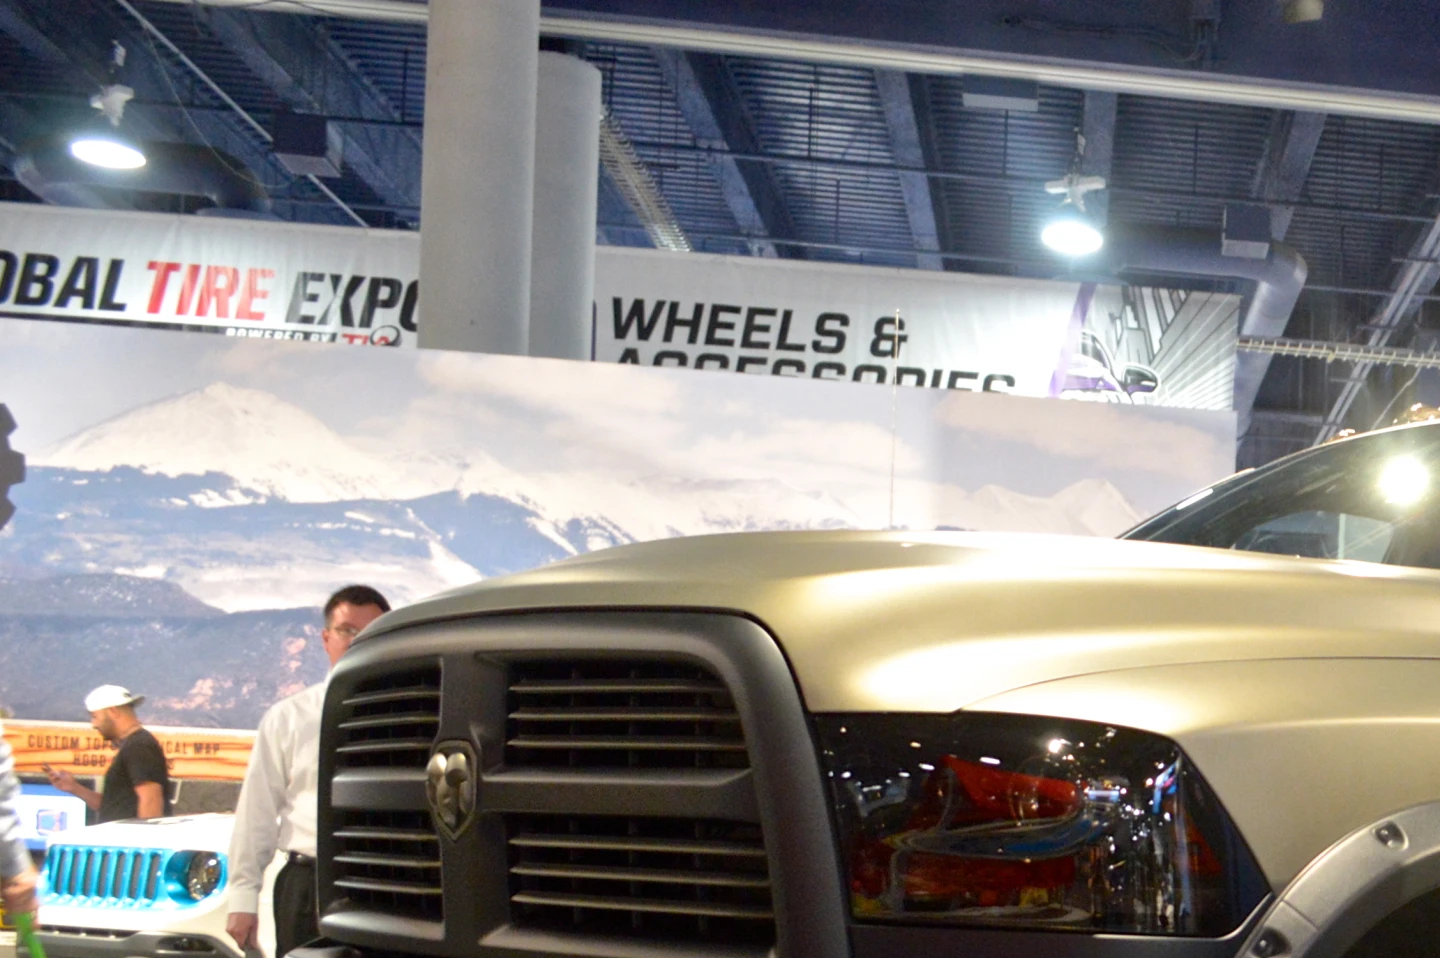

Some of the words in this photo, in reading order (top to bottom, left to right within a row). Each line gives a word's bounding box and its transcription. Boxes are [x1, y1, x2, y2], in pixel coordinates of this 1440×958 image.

[146, 260, 274, 321] TIRE
[611, 296, 850, 354] WHEELS
[869, 316, 908, 359] &
[28, 734, 80, 750] CUSTOM
